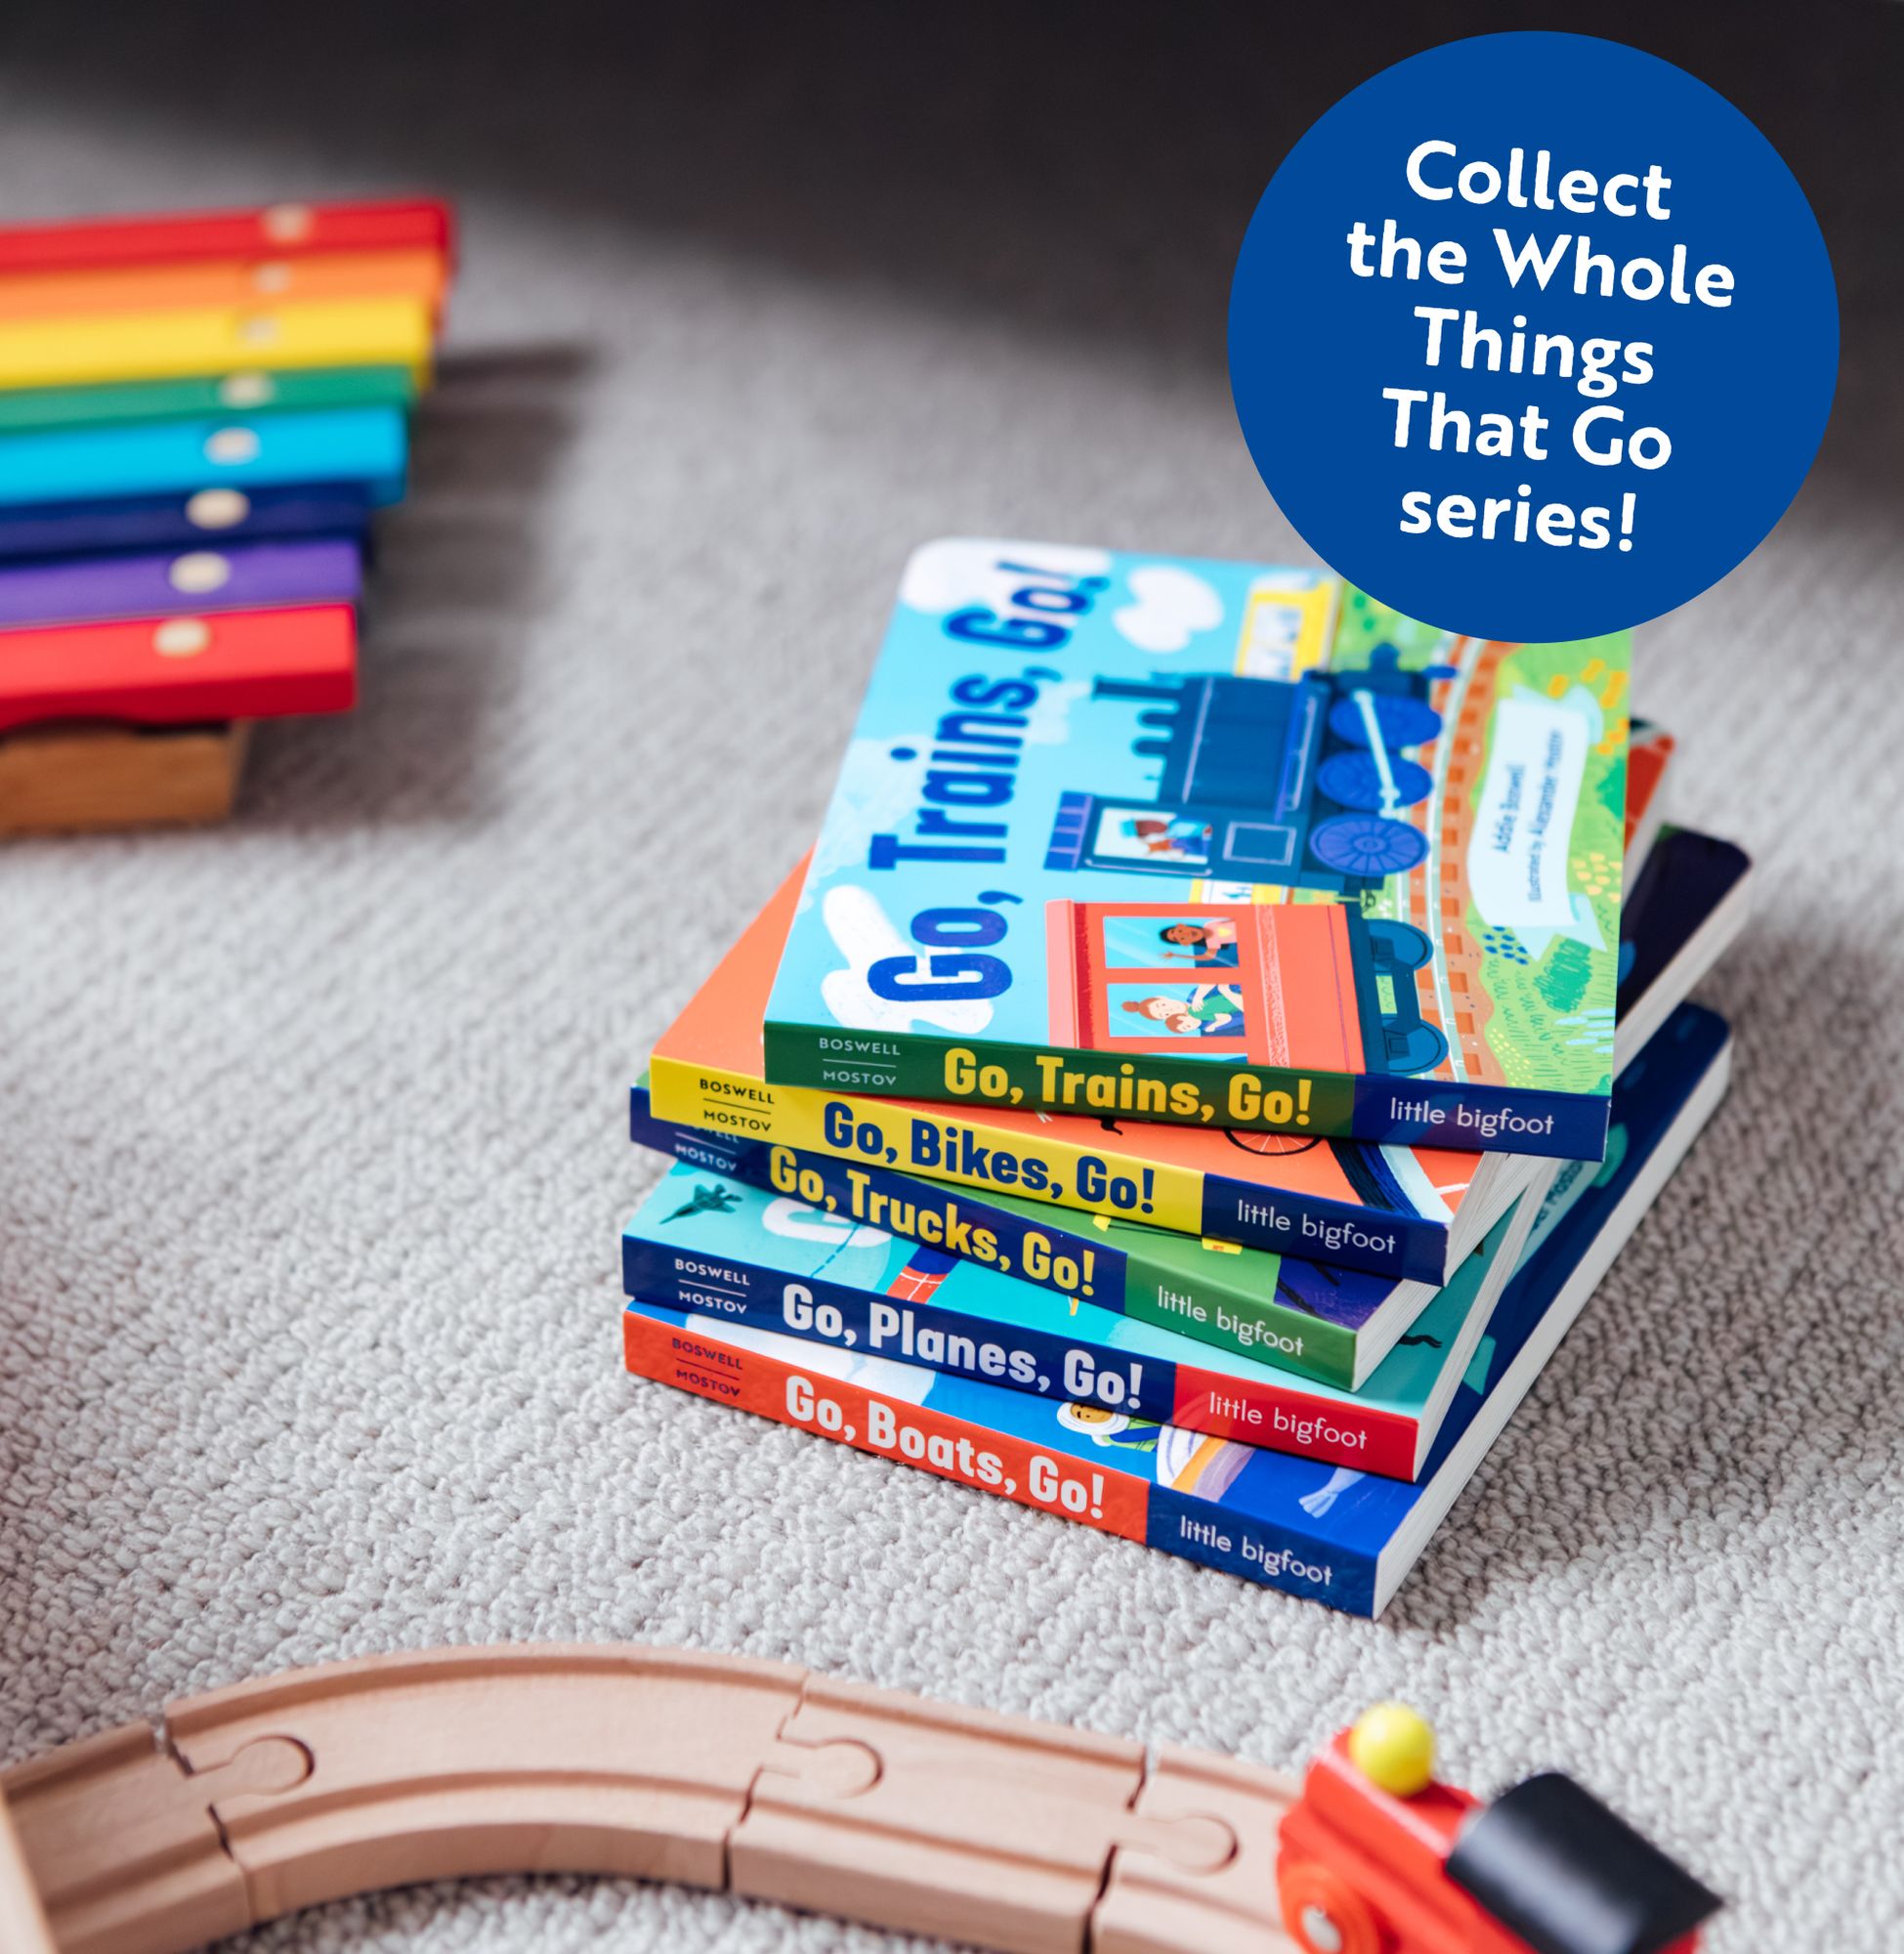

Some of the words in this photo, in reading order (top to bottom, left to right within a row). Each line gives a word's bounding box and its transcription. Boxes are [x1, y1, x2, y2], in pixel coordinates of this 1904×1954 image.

[941, 560, 1111, 652] Go!
[867, 665, 1063, 870] Trains,
[867, 889, 1023, 1002] Go,
[819, 1038, 901, 1056] BOSWELL
[699, 1078, 775, 1105] BOSWELL
[823, 1071, 896, 1085] MOSTOV
[944, 1047, 1023, 1104] Go,
[1036, 1055, 1214, 1122] Trains,
[1228, 1074, 1312, 1126] Go!
[703, 1109, 772, 1132] MOSTOV
[1390, 1097, 1446, 1125] little
[1457, 1108, 1554, 1137] bigfoot
[675, 1144, 737, 1171] MOSTOV
[824, 1101, 898, 1164] Go,
[910, 1118, 1063, 1199] Bikes,
[1076, 1156, 1155, 1214] Go!
[770, 1145, 837, 1211] Go,
[846, 1168, 1009, 1272] Trucks,
[1022, 1231, 1095, 1296] Go!
[1238, 1199, 1290, 1231] little
[1301, 1213, 1396, 1253] bigfoot
[674, 1258, 749, 1286] BOSWELL
[678, 1291, 746, 1314] MOSTOV
[1158, 1285, 1207, 1322] little
[1216, 1301, 1304, 1357] bigfoot
[671, 1338, 742, 1370] BOSWELL
[783, 1284, 857, 1346] Go,
[868, 1302, 1050, 1392] Planes,
[1063, 1349, 1143, 1409] Go!
[676, 1369, 740, 1397] MOSTOV
[785, 1375, 857, 1441] Go,
[867, 1399, 1017, 1496] Boats,
[1029, 1455, 1105, 1519] Go!
[1209, 1391, 1262, 1424] little
[1274, 1407, 1367, 1449] bigfoot
[1180, 1515, 1232, 1551] little
[1242, 1536, 1333, 1586] bigfoot
